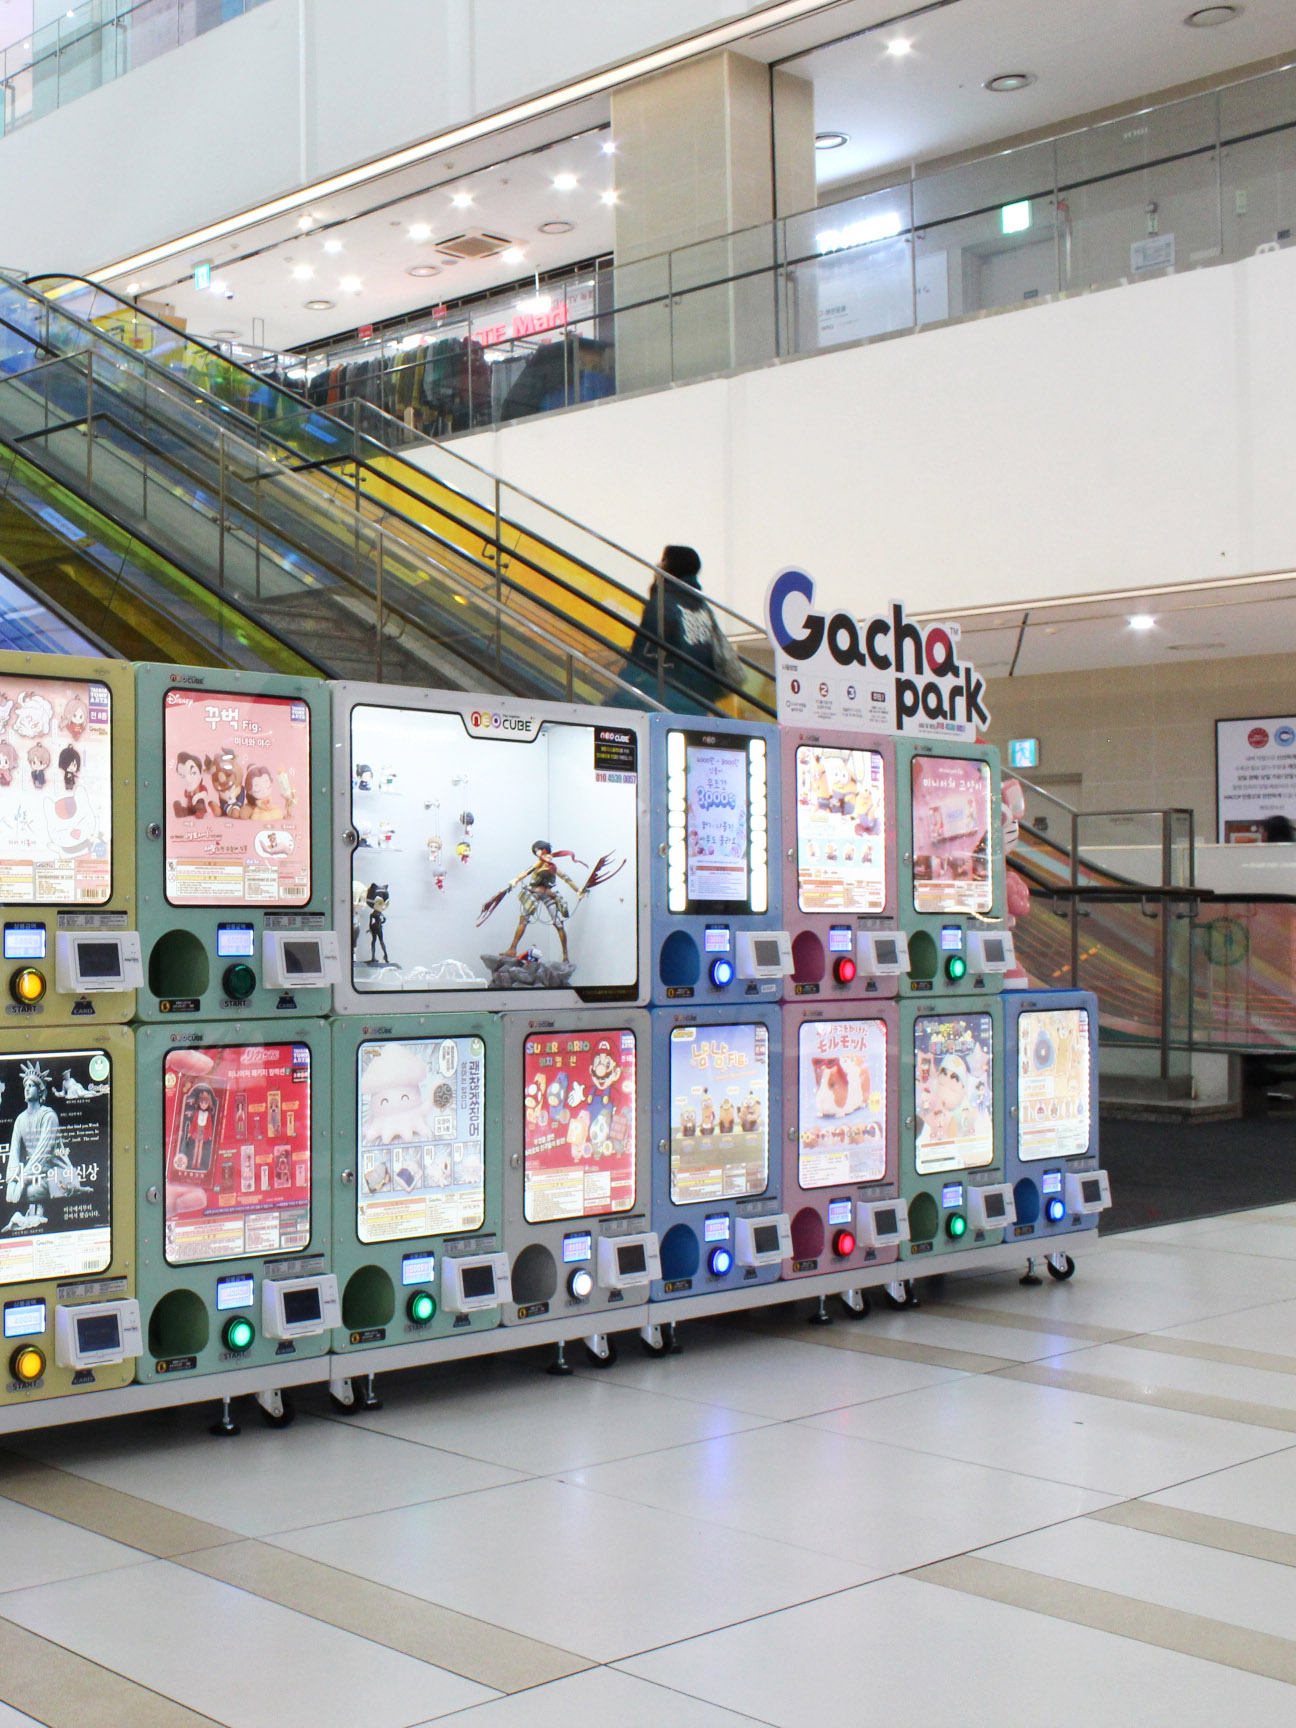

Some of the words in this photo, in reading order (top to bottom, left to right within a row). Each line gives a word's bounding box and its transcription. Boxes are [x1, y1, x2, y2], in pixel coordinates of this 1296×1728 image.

[769, 571, 960, 678] Gacha
[895, 667, 988, 730] park
[205, 706, 239, 731] 꾸벅
[242, 720, 262, 734] Fig.
[502, 719, 532, 732] CUBE
[11, 1005, 37, 1013] START
[224, 1000, 246, 1008] START
[526, 1041, 558, 1054] SUER
[817, 1034, 868, 1053] モルモット
[8, 1162, 58, 1188] 자유의
[62, 1163, 99, 1183] 여신상
[224, 1351, 245, 1360] START
[12, 1381, 38, 1391] START
